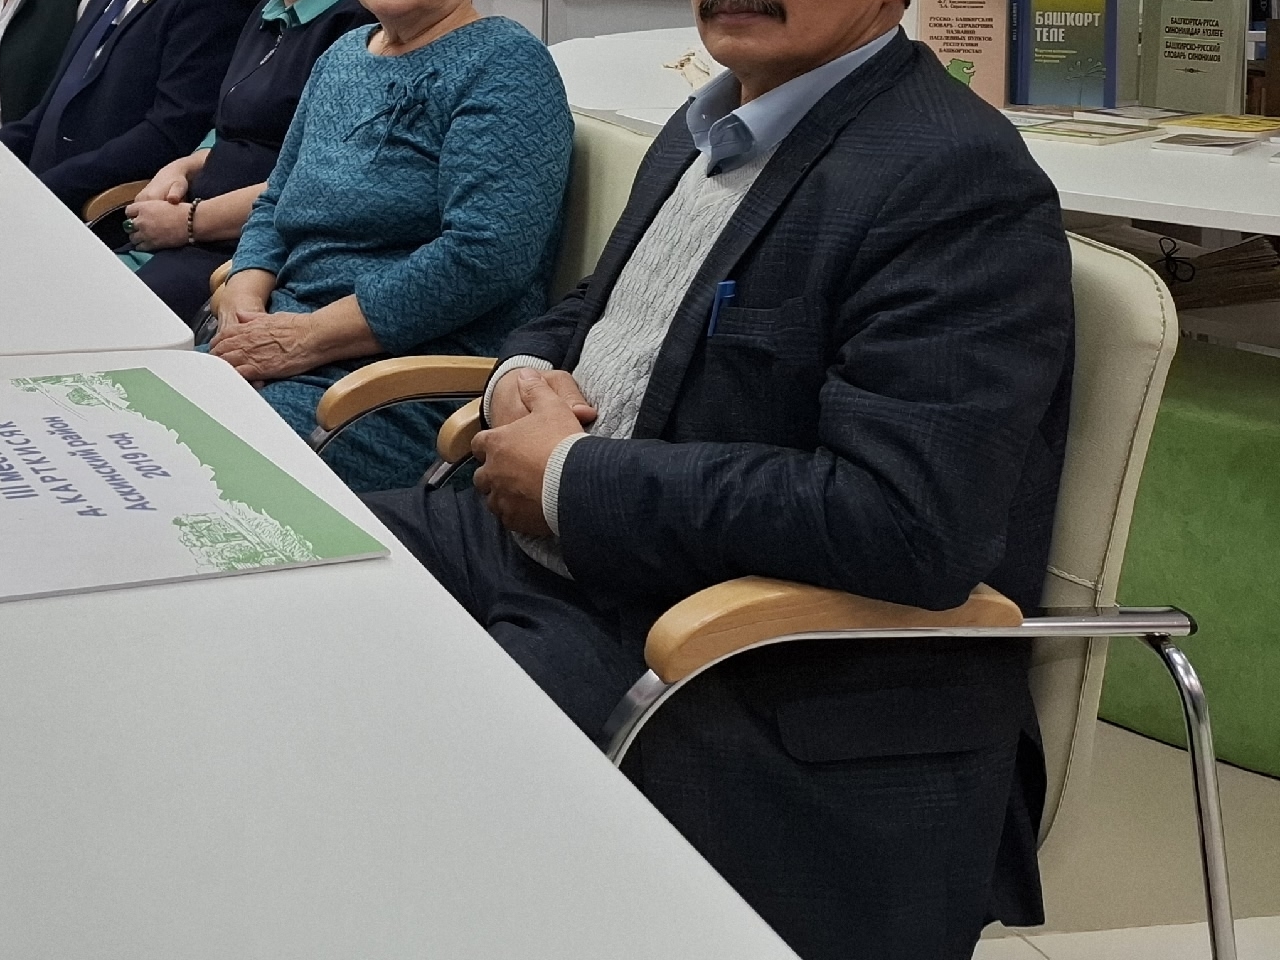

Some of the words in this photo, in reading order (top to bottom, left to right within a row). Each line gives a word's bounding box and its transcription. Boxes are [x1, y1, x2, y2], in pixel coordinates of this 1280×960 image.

[42, 416, 98, 448] район
[106, 431, 140, 450] год
[66, 448, 158, 511] Аскинский
[120, 452, 172, 480] 2019
